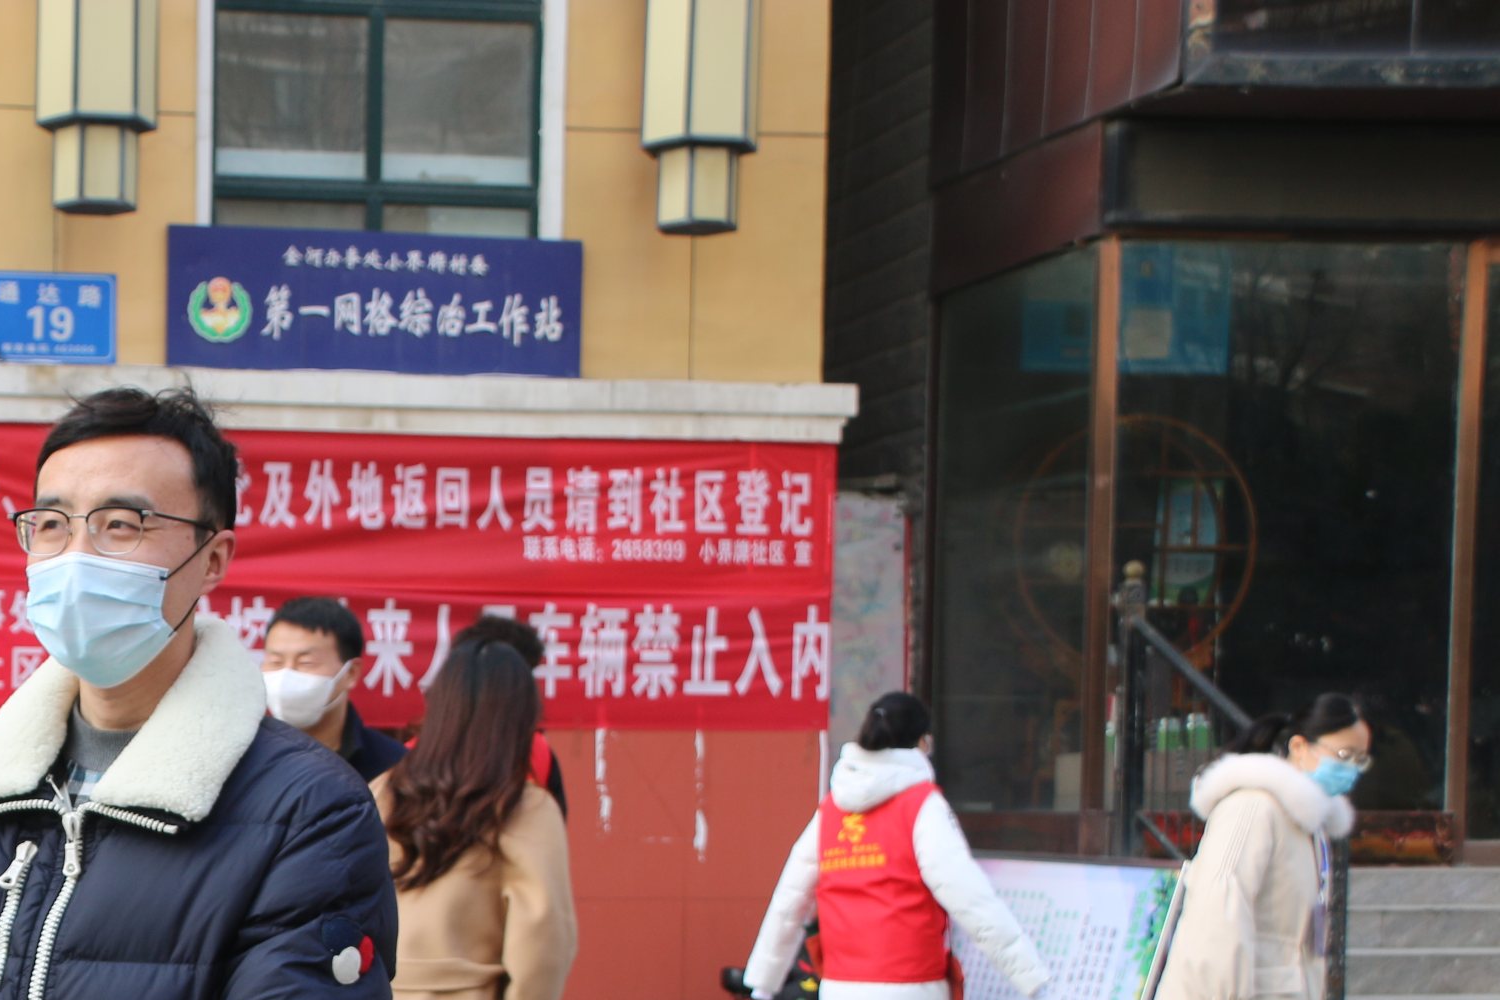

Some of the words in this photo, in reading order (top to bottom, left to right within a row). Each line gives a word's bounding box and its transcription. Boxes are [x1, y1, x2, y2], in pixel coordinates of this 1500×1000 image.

[26, 305, 74, 341] 19
[261, 284, 563, 346] 第一网格综治工作站
